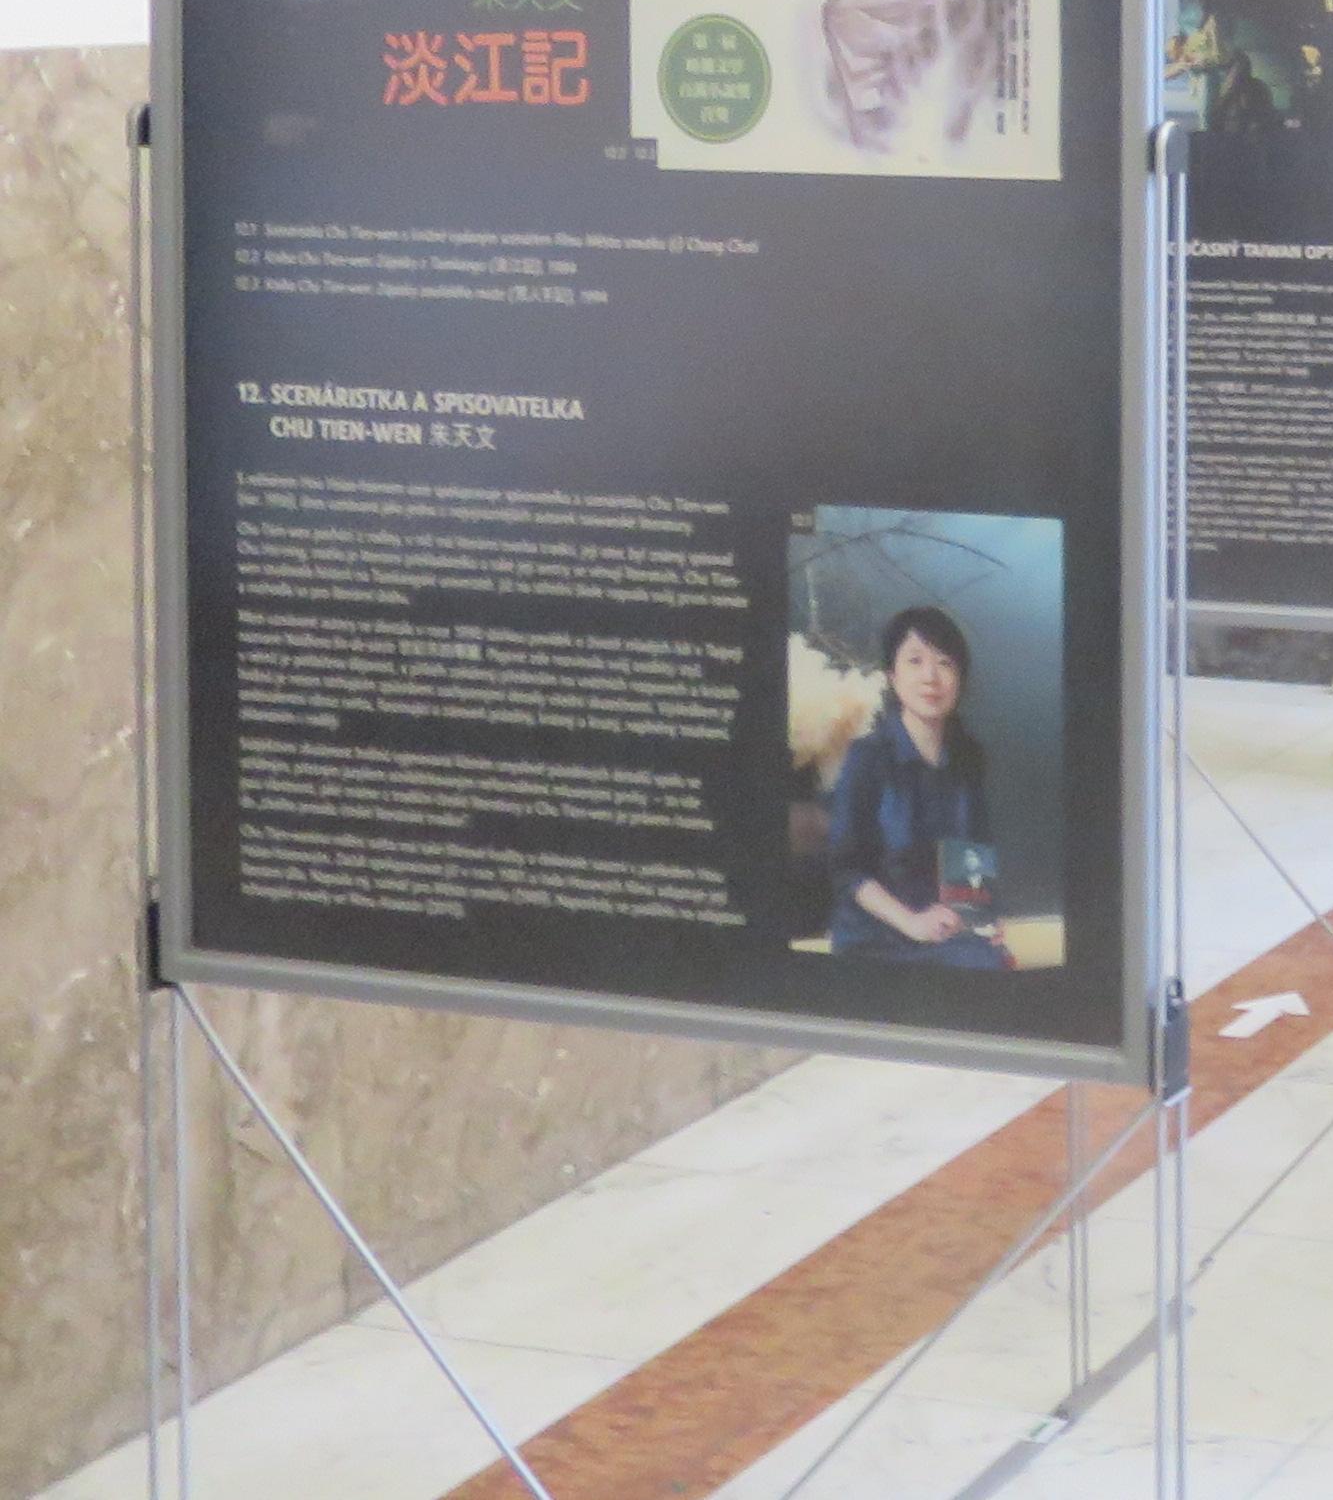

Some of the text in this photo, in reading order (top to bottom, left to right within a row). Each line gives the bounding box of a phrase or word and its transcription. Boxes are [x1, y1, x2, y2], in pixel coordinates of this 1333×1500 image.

[381, 29, 593, 107] 淡江記
[271, 380, 408, 412] SCENÁRISTKA
[412, 390, 429, 413] A
[433, 391, 585, 420] SPISOVATELKA
[269, 415, 496, 451] CHU TIEN-WEN 朱天文
